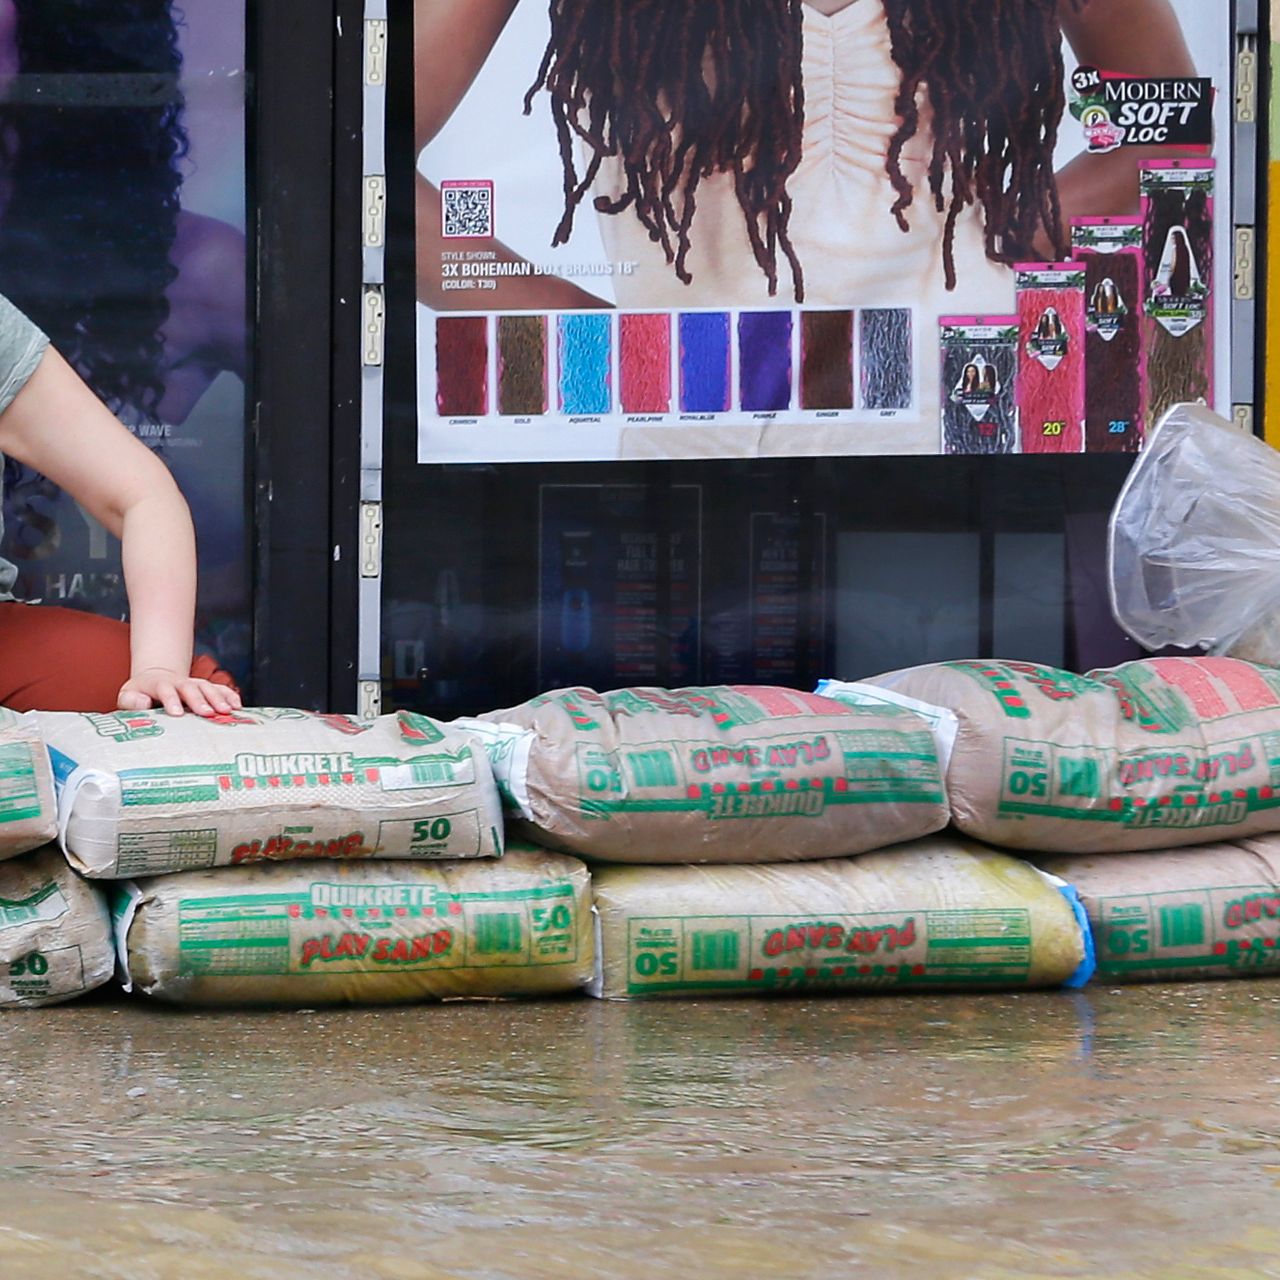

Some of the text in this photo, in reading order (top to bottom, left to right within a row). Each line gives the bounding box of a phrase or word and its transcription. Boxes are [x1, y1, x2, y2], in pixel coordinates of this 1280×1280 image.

[1104, 80, 1203, 101] MODERN
[1118, 102, 1198, 127] SOFT
[1126, 127, 1168, 143] LOC
[441, 251, 466, 261] STYLE
[441, 263, 459, 277] 3X
[461, 262, 531, 277] BOHEMIAN
[139, 424, 172, 437] WAVE
[235, 751, 356, 777] QUIKRETE
[1008, 771, 1049, 797] 50
[412, 816, 452, 842] 50
[310, 882, 438, 908] QUIKRETE
[532, 902, 573, 932] 50
[301, 930, 454, 967] PLAY SAND
[1107, 929, 1150, 955] 50
[635, 952, 679, 977] 50
